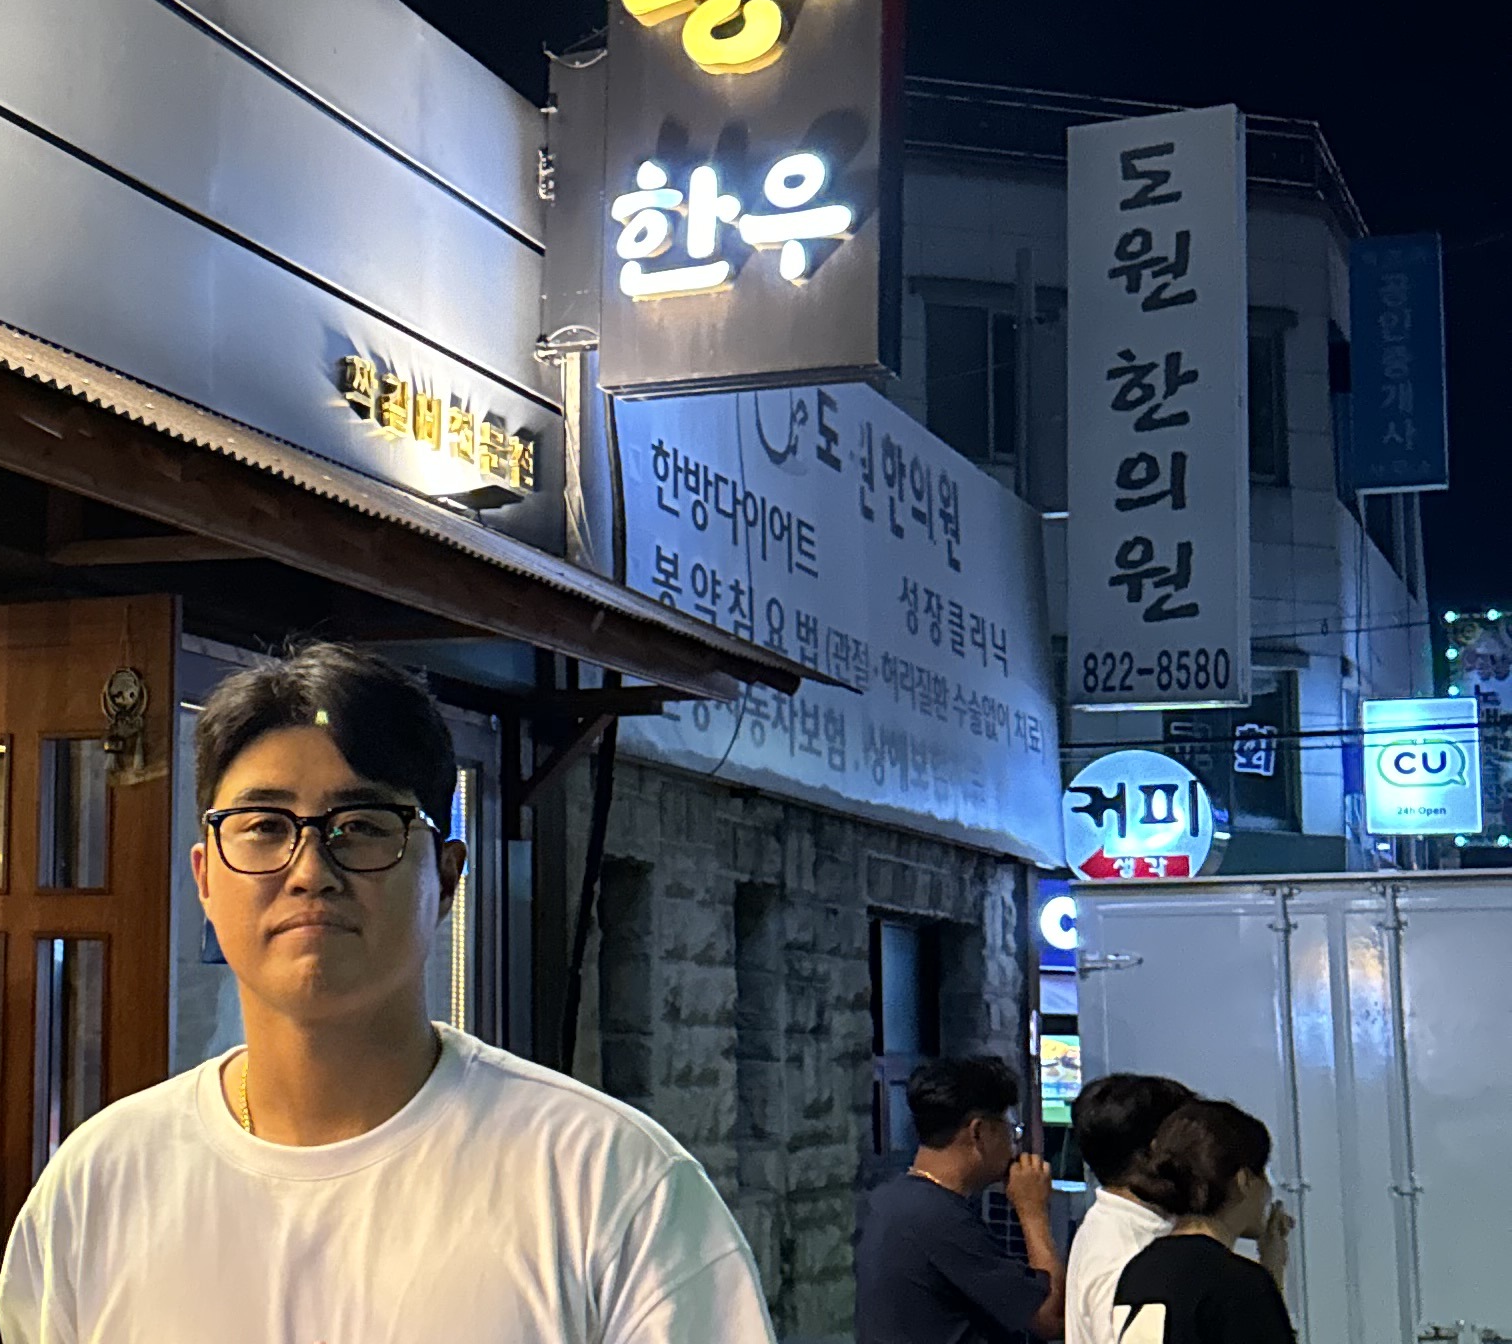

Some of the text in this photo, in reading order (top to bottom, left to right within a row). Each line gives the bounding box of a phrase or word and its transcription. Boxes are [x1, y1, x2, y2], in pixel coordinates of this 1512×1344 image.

[611, 150, 855, 299] 한우
[651, 438, 819, 579] 한방다이어트
[899, 575, 1009, 678] 성장클리닉
[1082, 647, 1231, 694] 822-8580
[1394, 750, 1447, 775] CU
[1418, 806, 1447, 816] Open
[1113, 857, 1168, 878] 생각
